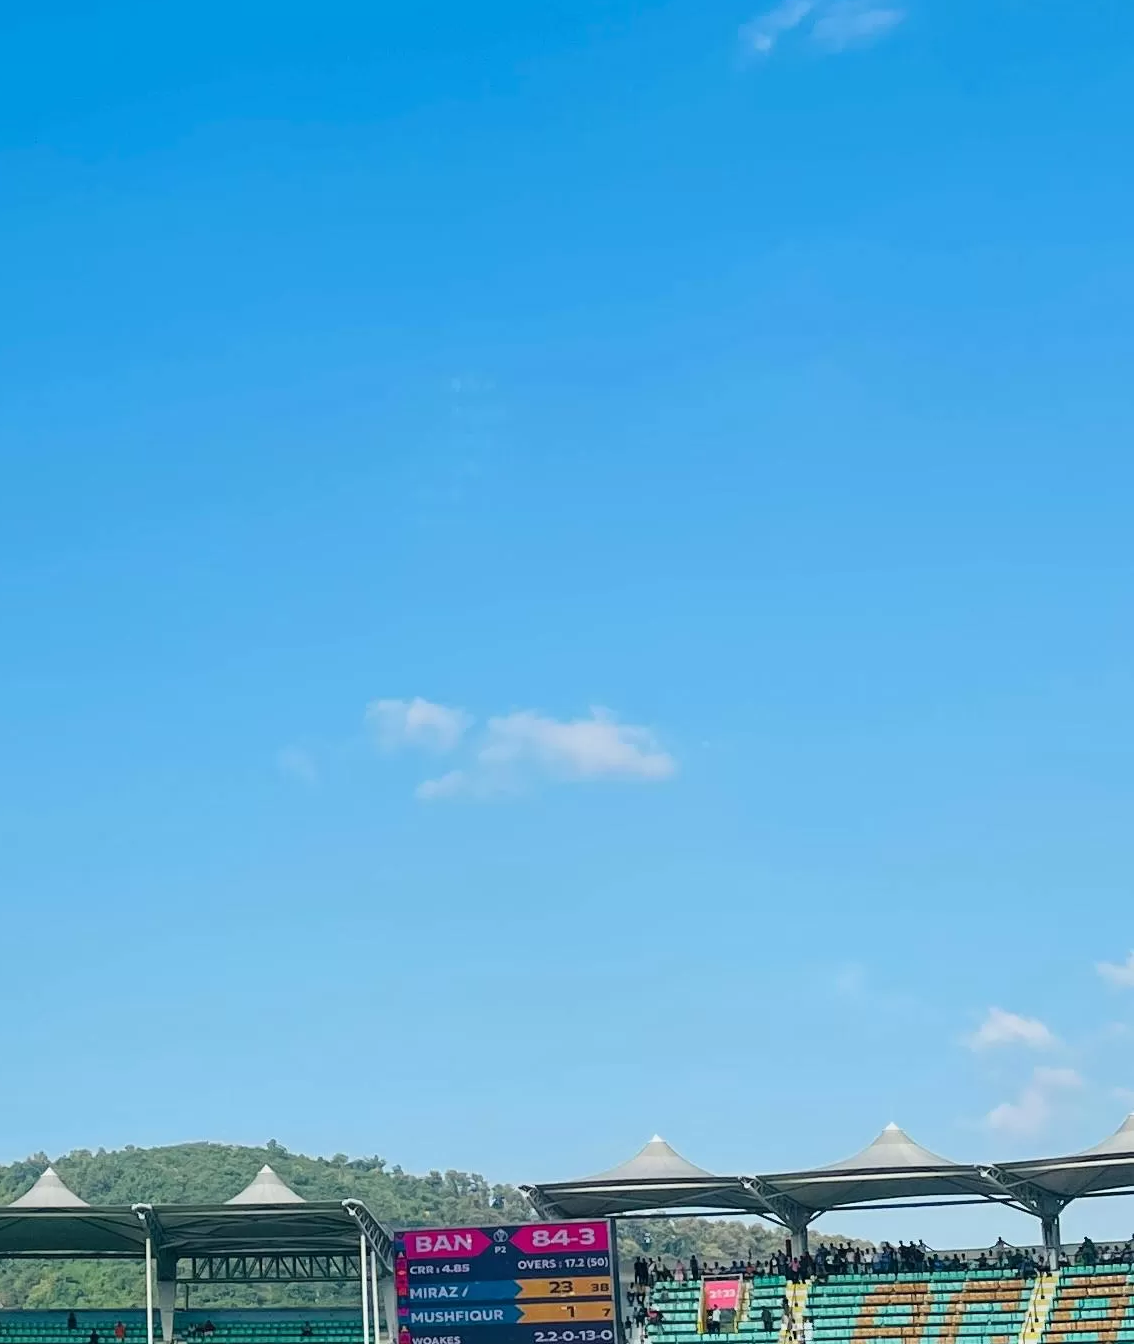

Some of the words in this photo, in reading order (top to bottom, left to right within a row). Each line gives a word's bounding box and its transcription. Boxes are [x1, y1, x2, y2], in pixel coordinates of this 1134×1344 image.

[417, 1234, 472, 1253] BAN
[532, 1228, 596, 1247] 84-3
[494, 1246, 507, 1254] P2
[409, 1265, 435, 1275] CRR
[441, 1263, 470, 1274] 4.85
[517, 1259, 557, 1270] OVERS
[564, 1257, 585, 1269] 17.2
[586, 1256, 609, 1269] (50)
[409, 1286, 459, 1299] MIRAZ
[549, 1281, 574, 1293] 23
[591, 1283, 610, 1293] 38
[411, 1309, 504, 1323] MUSHFIQUR
[566, 1306, 576, 1318] 1
[601, 1308, 611, 1317] 7
[534, 1329, 613, 1343] 2.2-0-13-0
